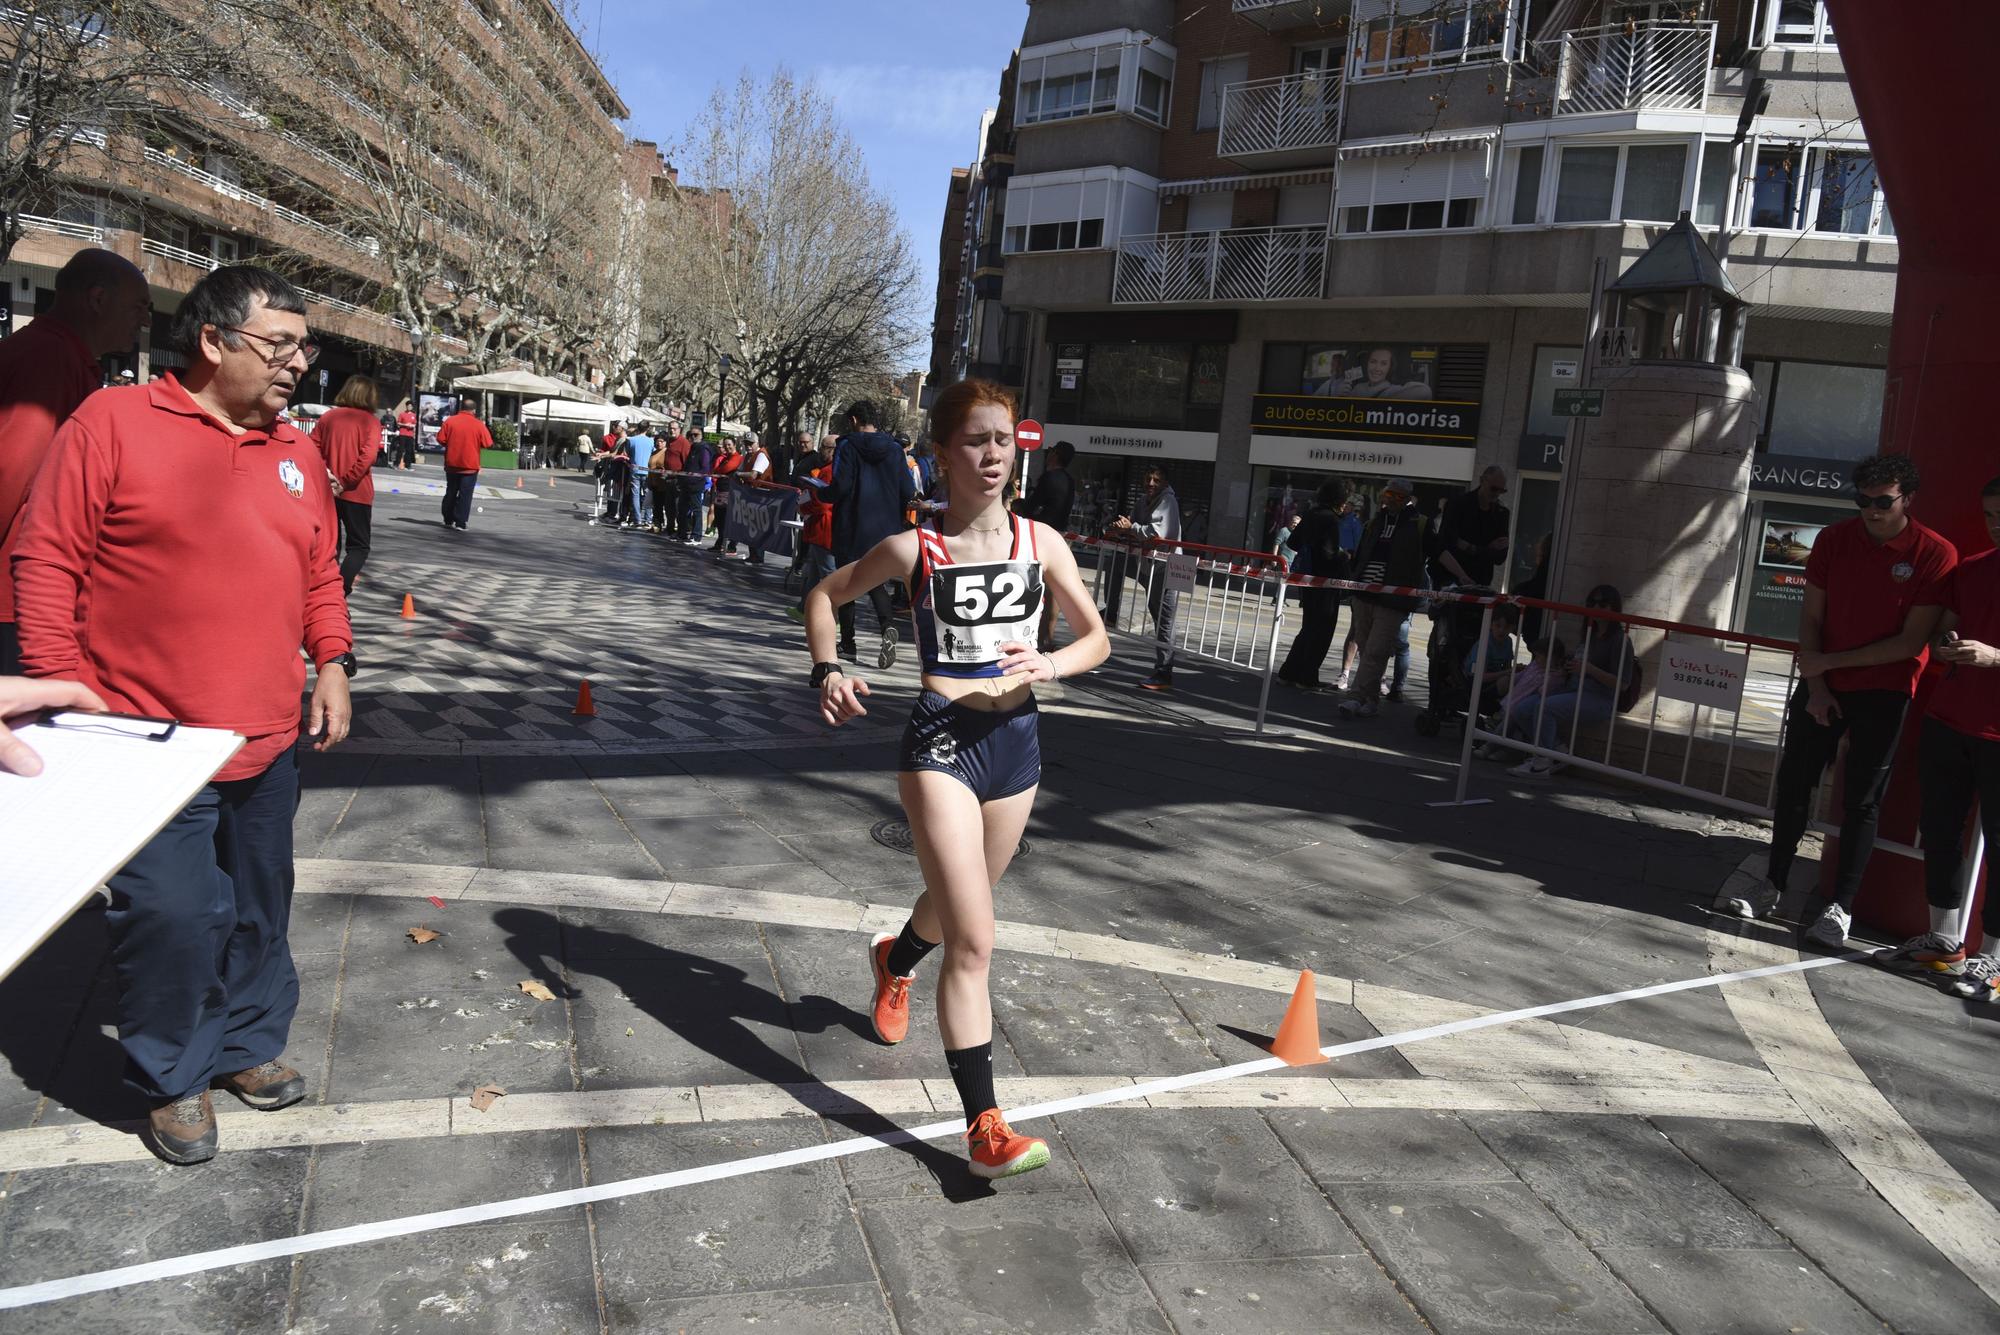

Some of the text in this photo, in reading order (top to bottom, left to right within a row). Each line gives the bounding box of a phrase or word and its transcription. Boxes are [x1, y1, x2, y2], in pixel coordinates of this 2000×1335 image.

[1750, 464, 1841, 490] RANCES
[953, 572, 1026, 620] 52
[1673, 672, 1728, 690] 93 876 44 44
